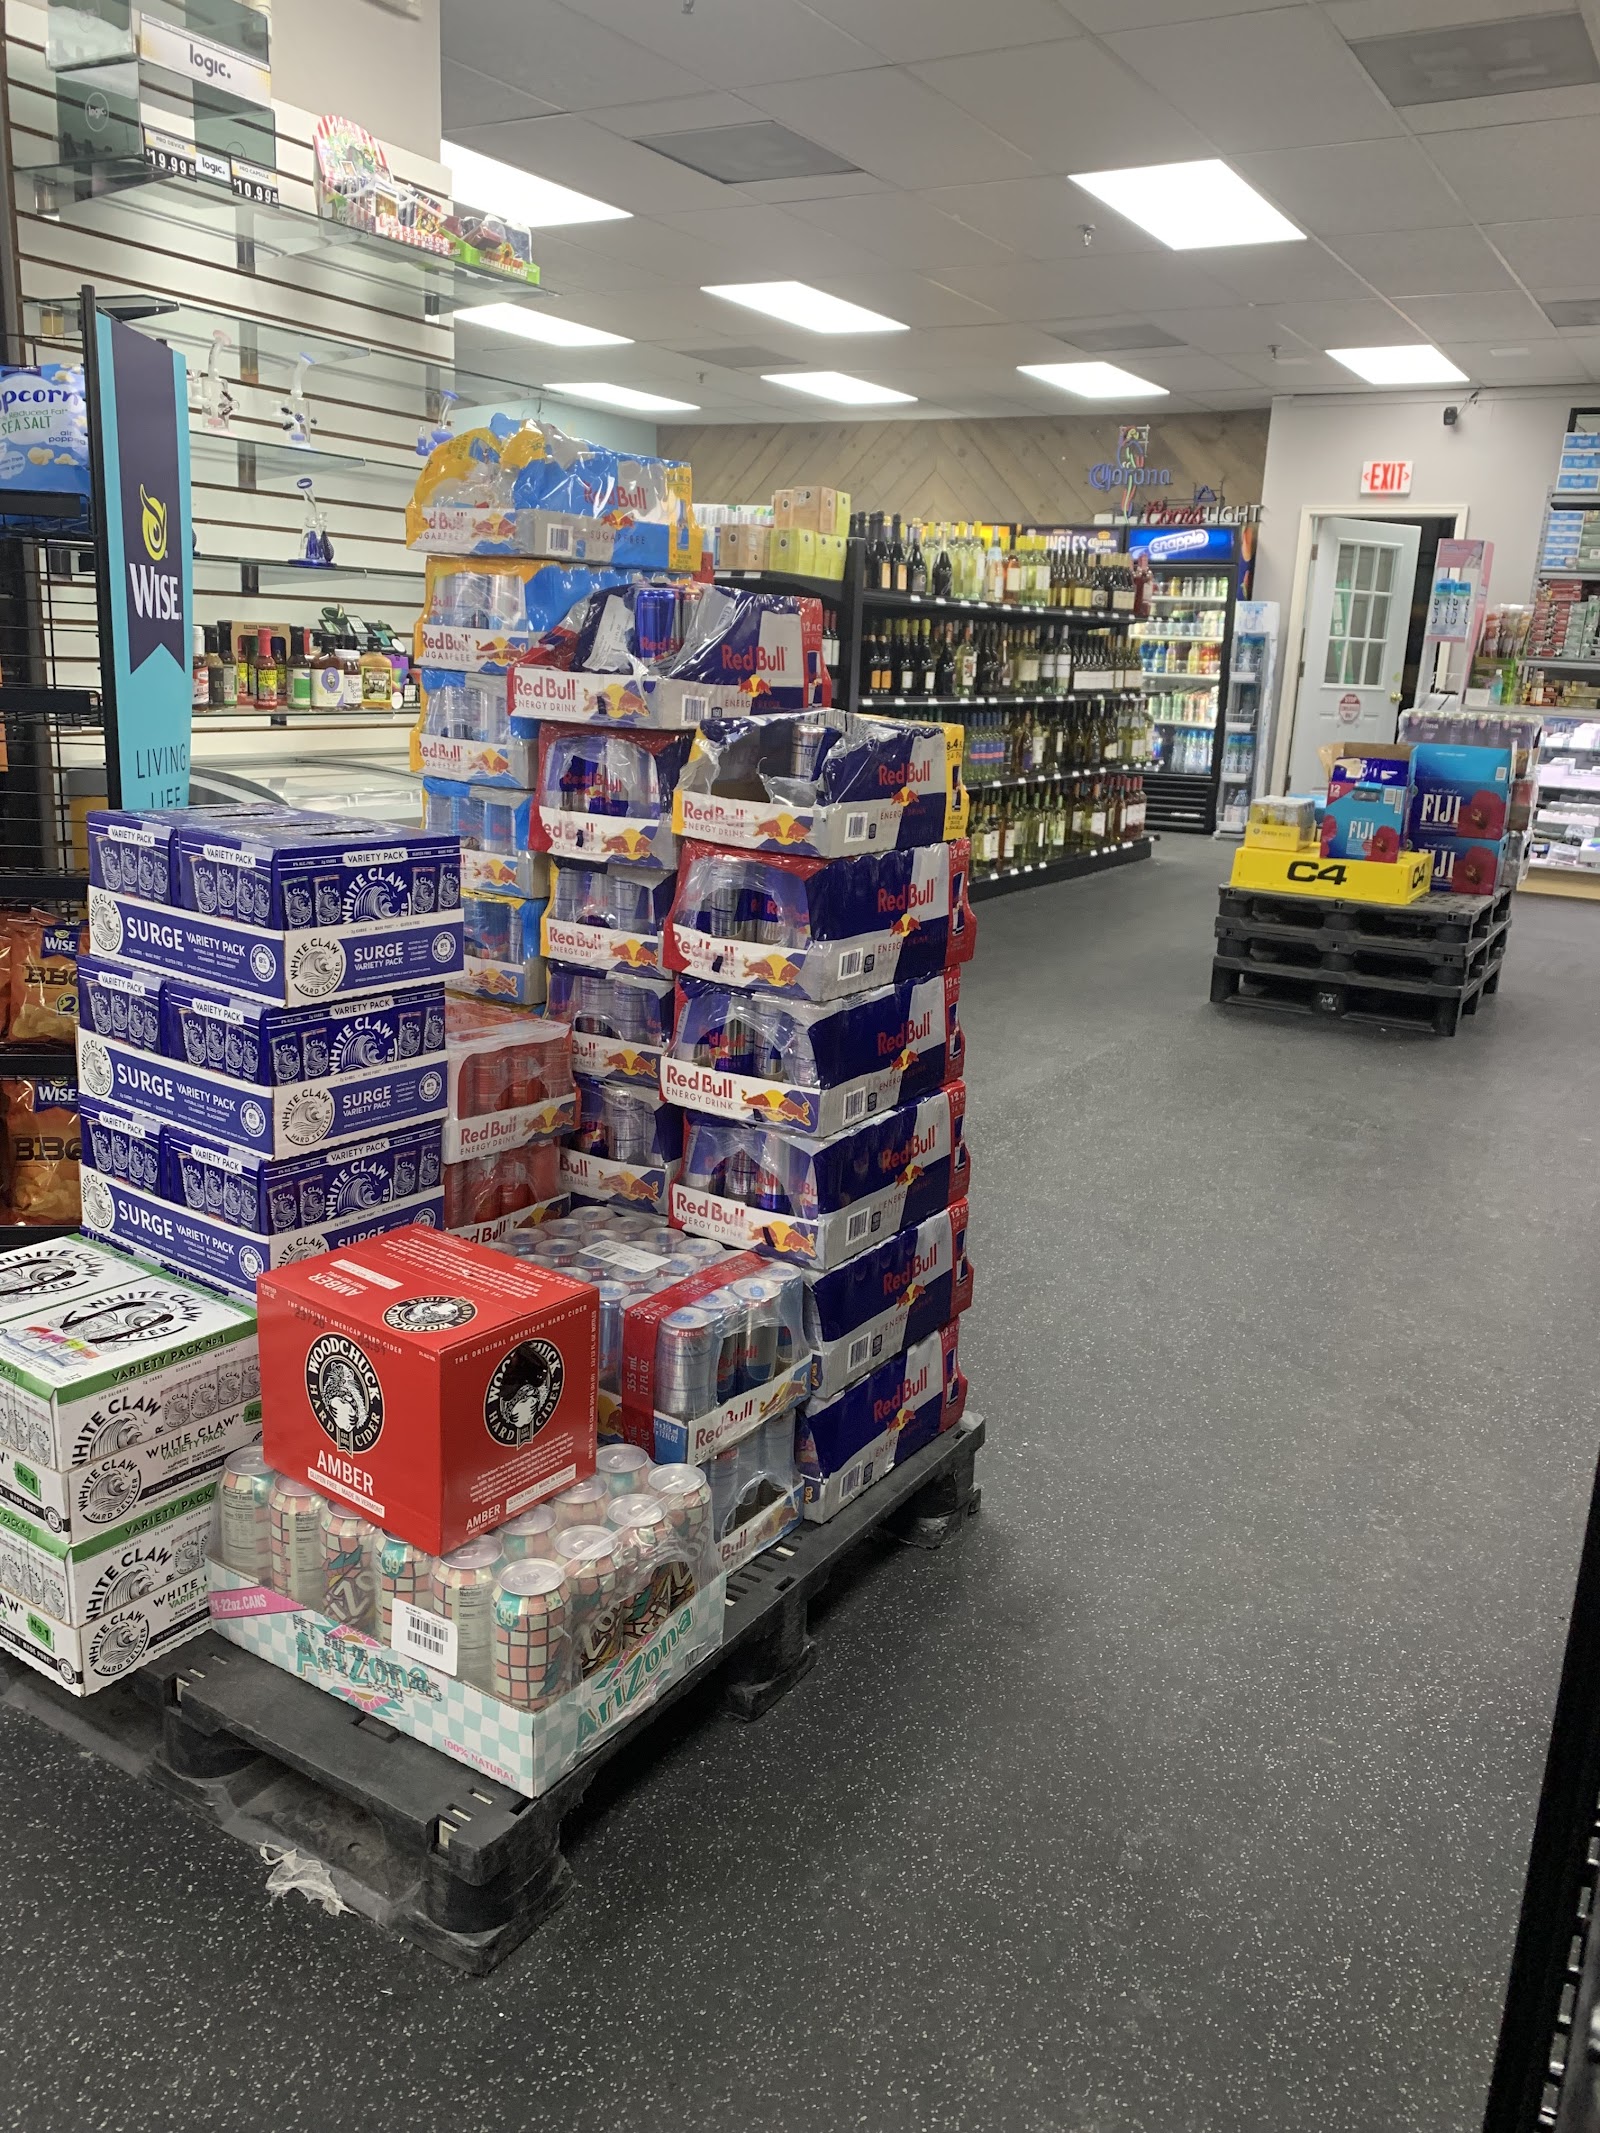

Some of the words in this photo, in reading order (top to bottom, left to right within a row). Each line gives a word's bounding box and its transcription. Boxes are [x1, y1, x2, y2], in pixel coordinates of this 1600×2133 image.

[189, 43, 232, 79] logic.
[146, 148, 187, 176] $19.99
[202, 156, 226, 175] logic.
[233, 178, 272, 204] $10.99
[1, 420, 22, 436] SEA
[24, 415, 52, 430] SALT
[1089, 463, 1171, 490] Corona
[1369, 462, 1406, 491] EXIT
[1206, 504, 1263, 523] LIGHT
[1152, 530, 1205, 553] snapple
[128, 562, 180, 621] WISE
[721, 643, 754, 671] Red
[755, 646, 785, 672] Bull
[513, 674, 543, 698] Red
[545, 677, 576, 701] Bull
[549, 701, 577, 713] DRINK
[135, 743, 188, 780] LIVING
[878, 762, 905, 786] Red
[906, 760, 931, 782] Bull
[1420, 793, 1463, 823] FIJI
[682, 820, 717, 834] ENERGY
[718, 825, 745, 839] DRINK
[1349, 820, 1375, 840] FIJI
[206, 847, 235, 862] VARIETY
[235, 853, 253, 865] PACK
[347, 852, 381, 864] VARIETY
[383, 850, 405, 860] PACK
[1286, 860, 1348, 886] C4
[1412, 863, 1425, 889] C4
[876, 887, 906, 913] Red
[908, 878, 936, 908] Bull
[44, 936, 77, 952] WISE
[126, 916, 185, 952] SURGE
[185, 931, 220, 951] VARIETY
[221, 940, 247, 958] PACK
[290, 943, 309, 981] WHITE
[310, 937, 341, 955] CLAW
[353, 941, 404, 963] SURGE
[334, 1003, 369, 1016] VARIETY
[369, 999, 391, 1010] PACK
[877, 1022, 906, 1057] Red
[906, 1011, 931, 1044] Bull
[37, 1085, 78, 1102] WISE
[116, 1062, 175, 1102] SURGE
[176, 1082, 210, 1103] VARIETY
[212, 1095, 237, 1112] PACK
[666, 1064, 699, 1092] Red
[701, 1074, 733, 1099] Bull
[342, 1085, 392, 1109] SURGE
[666, 1086, 703, 1103] ENERGY
[705, 1096, 734, 1111] DRINK
[460, 1121, 489, 1146] Red
[490, 1115, 517, 1137] Bull
[460, 1139, 492, 1156] ENERGY
[492, 1134, 516, 1148] DRINK
[330, 1147, 365, 1163] VARIETY
[365, 1141, 387, 1152] PACK
[676, 1192, 709, 1218] Red
[711, 1202, 745, 1228] Bull
[117, 1200, 175, 1242] SURGE
[176, 1222, 210, 1244] VARIETY
[212, 1237, 236, 1256] PACK
[277, 1243, 295, 1269] HITE
[296, 1236, 325, 1252] CLAW
[307, 1271, 365, 1297] AMBER
[80, 1289, 169, 1311] WHITE
[169, 1292, 202, 1323] CLAW
[329, 1318, 361, 1337] AMERICAN
[382, 1341, 403, 1355] CIDER
[454, 1353, 469, 1365] THE
[471, 1339, 507, 1358] ORIGINAL
[509, 1323, 545, 1342] AMERICAN
[547, 1314, 566, 1326] HARD
[567, 1304, 588, 1318] CIDER
[111, 1352, 166, 1383] VARIETY
[170, 1341, 204, 1362] PACK
[307, 1336, 381, 1401] WOODCHUCK
[629, 1356, 637, 1371] mL
[640, 1360, 650, 1372] OZ
[627, 1371, 637, 1392] 355
[640, 1385, 649, 1396] 12
[309, 1383, 335, 1434] HARD
[354, 1411, 381, 1447] CIDER
[488, 1410, 515, 1441] HARD
[535, 1381, 561, 1427] CIDER
[145, 1432, 192, 1459] WHITE
[197, 1414, 236, 1440] CLAW
[15, 1466, 37, 1490] No.1
[78, 1466, 102, 1512] WHITE
[101, 1458, 138, 1473] CLAW
[316, 1449, 375, 1497] AMBER
[90, 1508, 115, 1521] HARD
[115, 1477, 139, 1515] SELTZER
[309, 1469, 326, 1485] GLUTEN
[326, 1478, 338, 1491] FREE
[341, 1485, 355, 1499] MADE
[360, 1495, 383, 1514] VERMONT
[466, 1503, 501, 1531] AMBER
[152, 1577, 199, 1608] WHITE
[29, 1617, 51, 1642] No.1
[88, 1622, 111, 1667] WHITE
[110, 1610, 146, 1626] CLAW
[100, 1662, 123, 1674] HARD
[122, 1626, 148, 1667] SELTZER
[576, 1605, 695, 1750] AriZona
[443, 1737, 469, 1760] 100%
[470, 1751, 517, 1785] NATURAL
